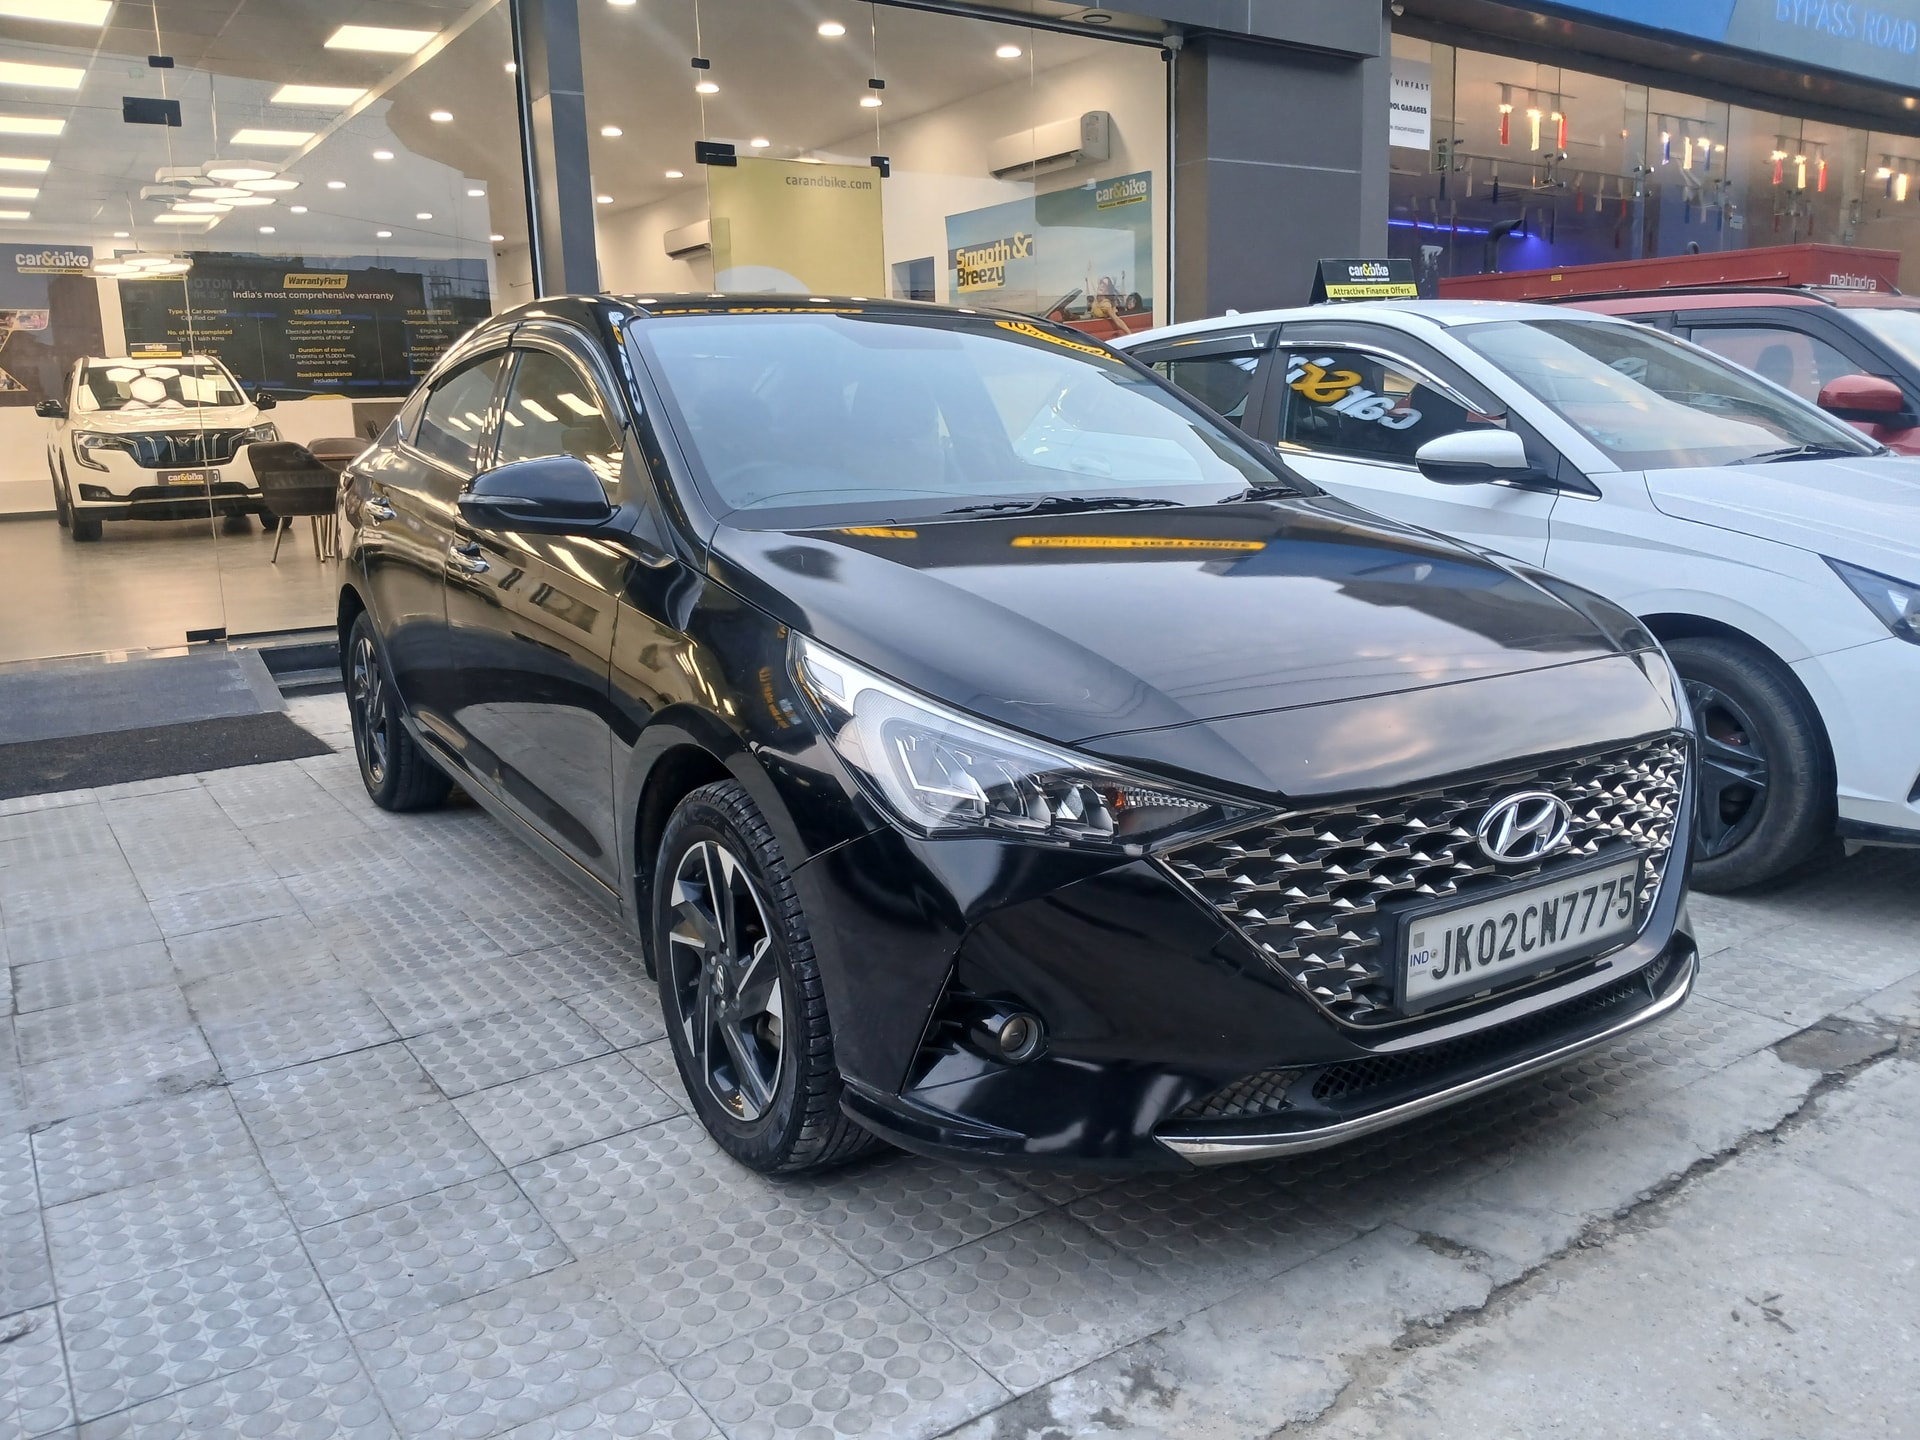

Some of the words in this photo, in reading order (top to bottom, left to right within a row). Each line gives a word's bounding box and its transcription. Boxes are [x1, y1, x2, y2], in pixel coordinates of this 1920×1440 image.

[1776, 0, 1856, 38] BYPASS
[1862, 10, 1917, 53] ROAD
[1395, 79, 1429, 91] VINFAST
[1401, 104, 1427, 114] GARAGES
[785, 175, 872, 190] carandbike.com
[1096, 178, 1147, 202] car&bike
[15, 250, 89, 267] car&bike
[956, 240, 1010, 268] Smooth
[1012, 232, 1033, 258] &
[957, 265, 1005, 287] Breezy
[1348, 262, 1389, 276] car&bike
[1829, 272, 1877, 290] mahindra
[232, 291, 263, 299] India's
[264, 291, 287, 299] most
[288, 291, 355, 301] comprehensive
[356, 292, 394, 301] warranty
[1333, 287, 1365, 296] Attractive
[1366, 287, 1389, 295] Finance
[1431, 873, 1635, 981] JK02CN7775
[1409, 950, 1430, 968] IND
